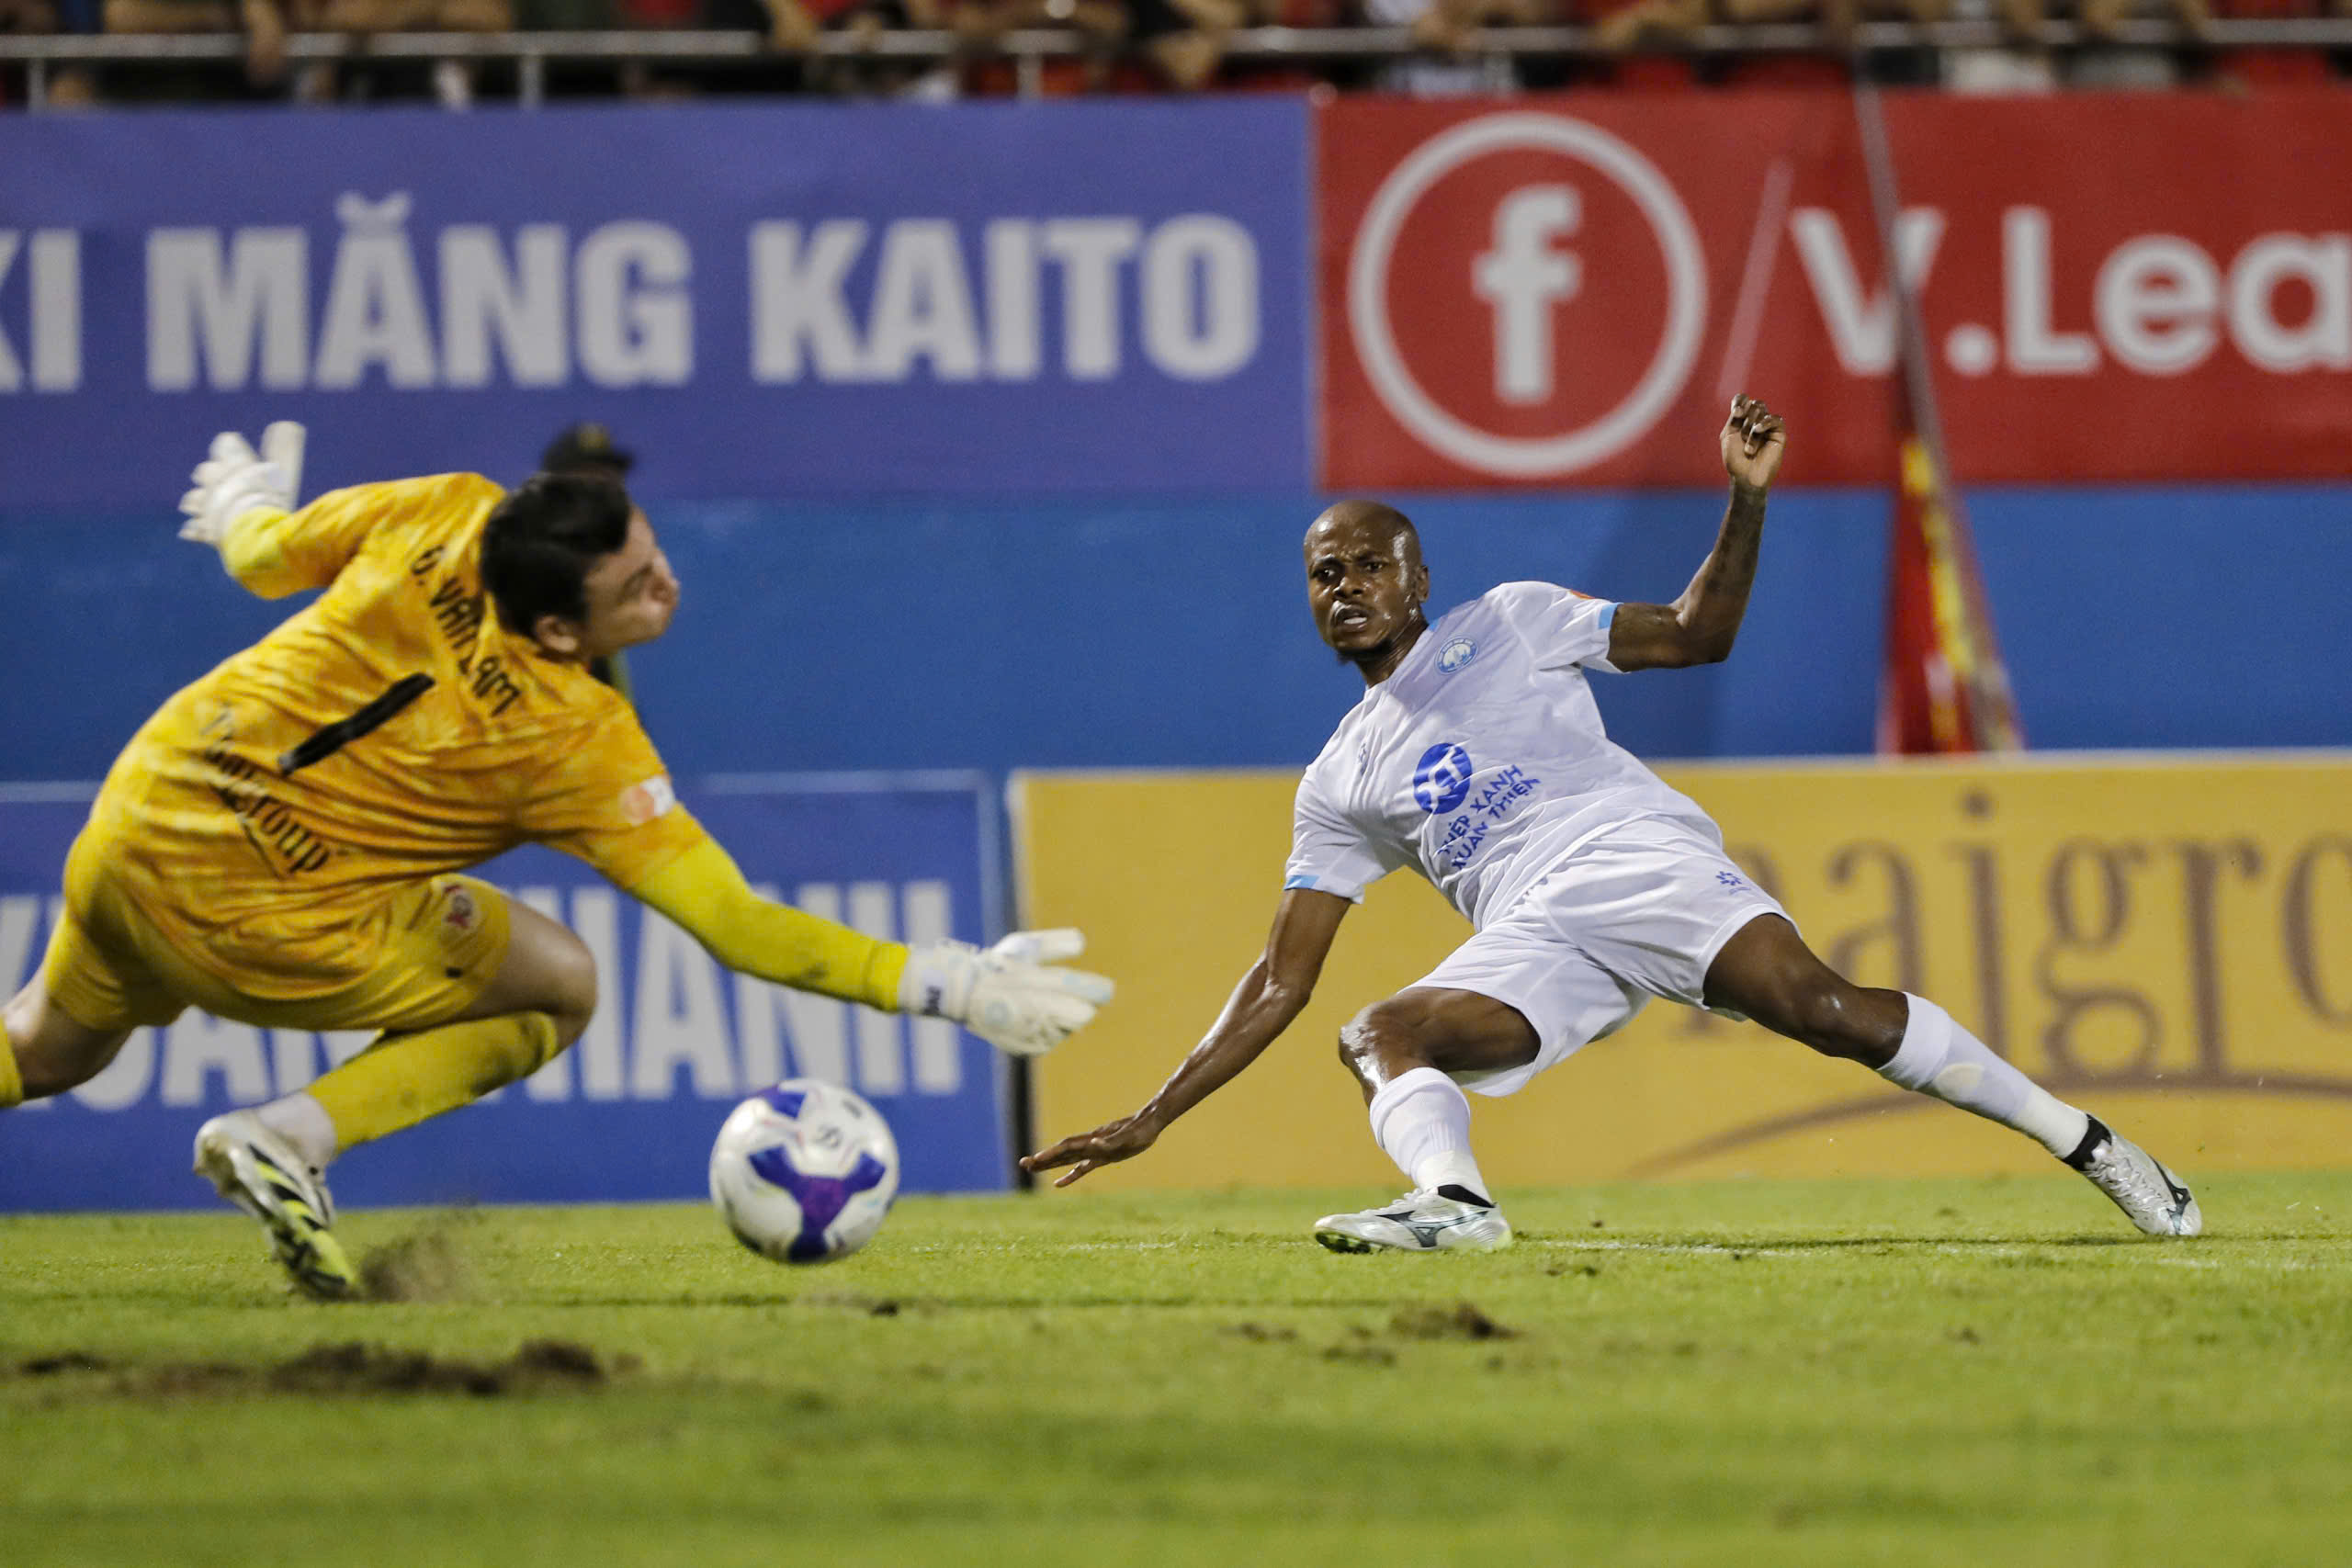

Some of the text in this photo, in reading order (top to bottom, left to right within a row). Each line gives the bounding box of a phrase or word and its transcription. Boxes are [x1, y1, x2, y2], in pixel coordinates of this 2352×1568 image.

[0, 191, 1261, 392] I MĂNG KAITO
[1470, 763, 1523, 814] XANH
